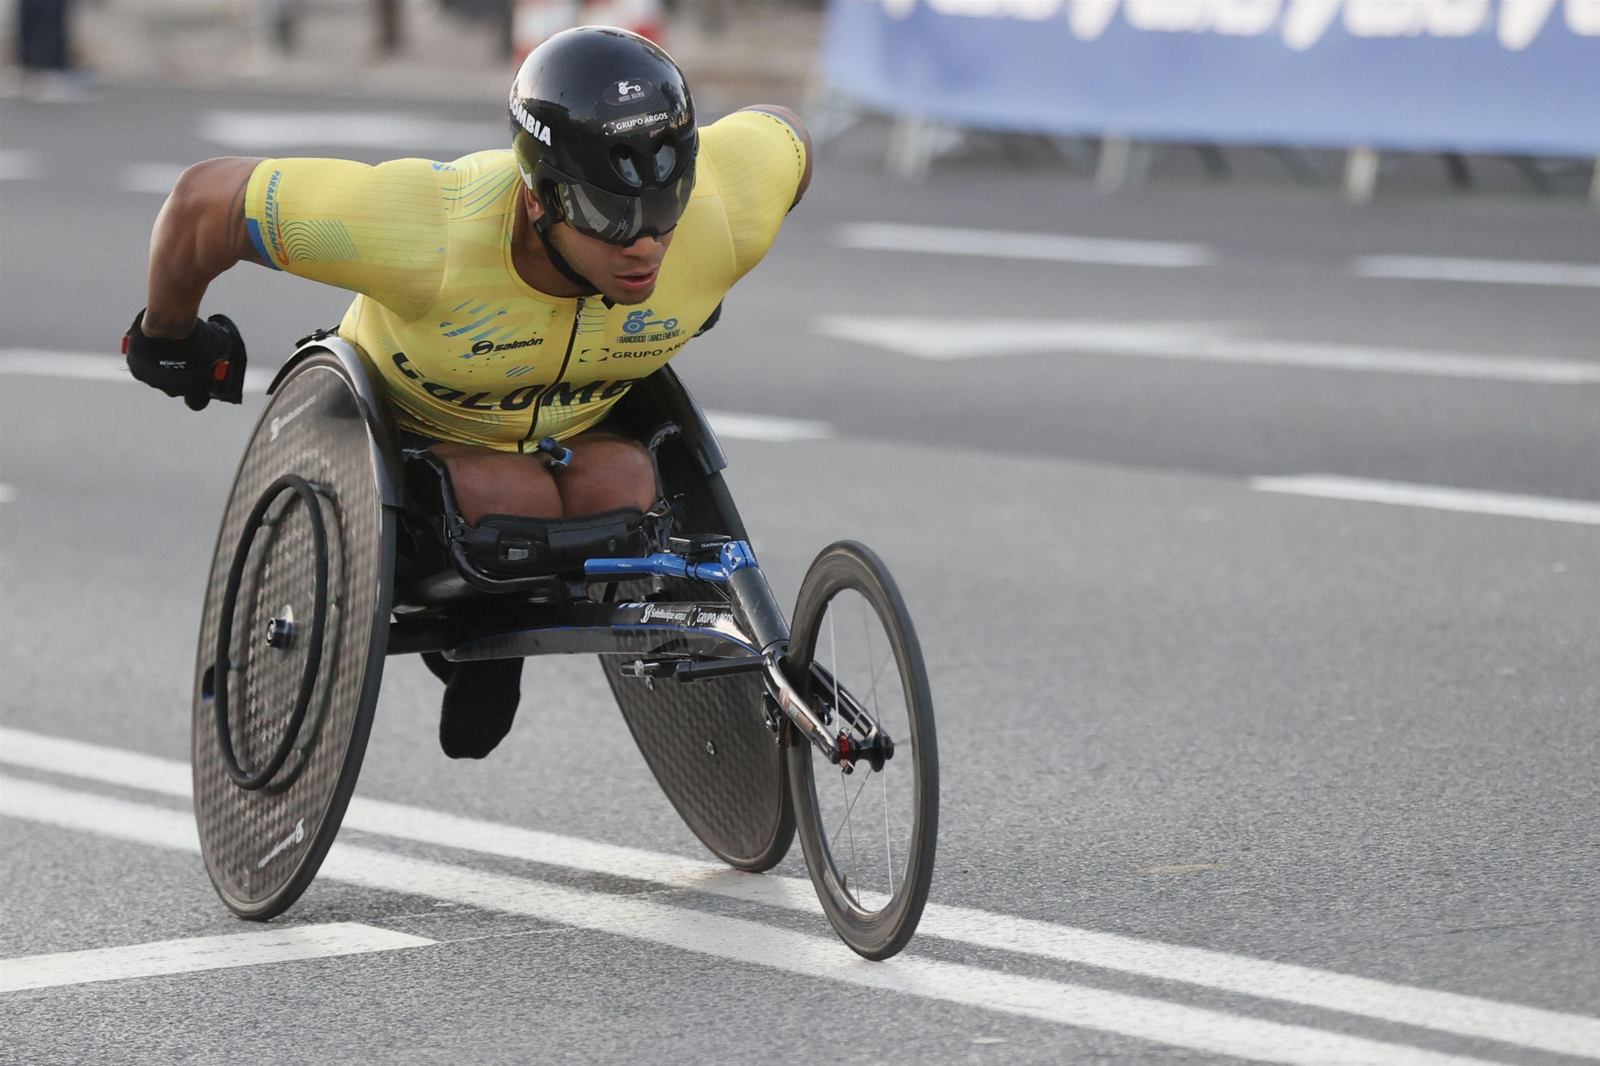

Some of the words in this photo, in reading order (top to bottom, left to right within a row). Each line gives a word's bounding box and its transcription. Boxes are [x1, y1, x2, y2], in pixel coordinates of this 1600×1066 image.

[616, 118, 643, 130] GRUPO
[644, 112, 669, 124] ARGOS
[266, 170, 281, 252] PARAATLETISMO
[493, 338, 544, 352] salmón
[612, 349, 663, 359] GRUPO
[701, 541, 725, 549] GARMIN
[696, 611, 717, 624] GRUPO
